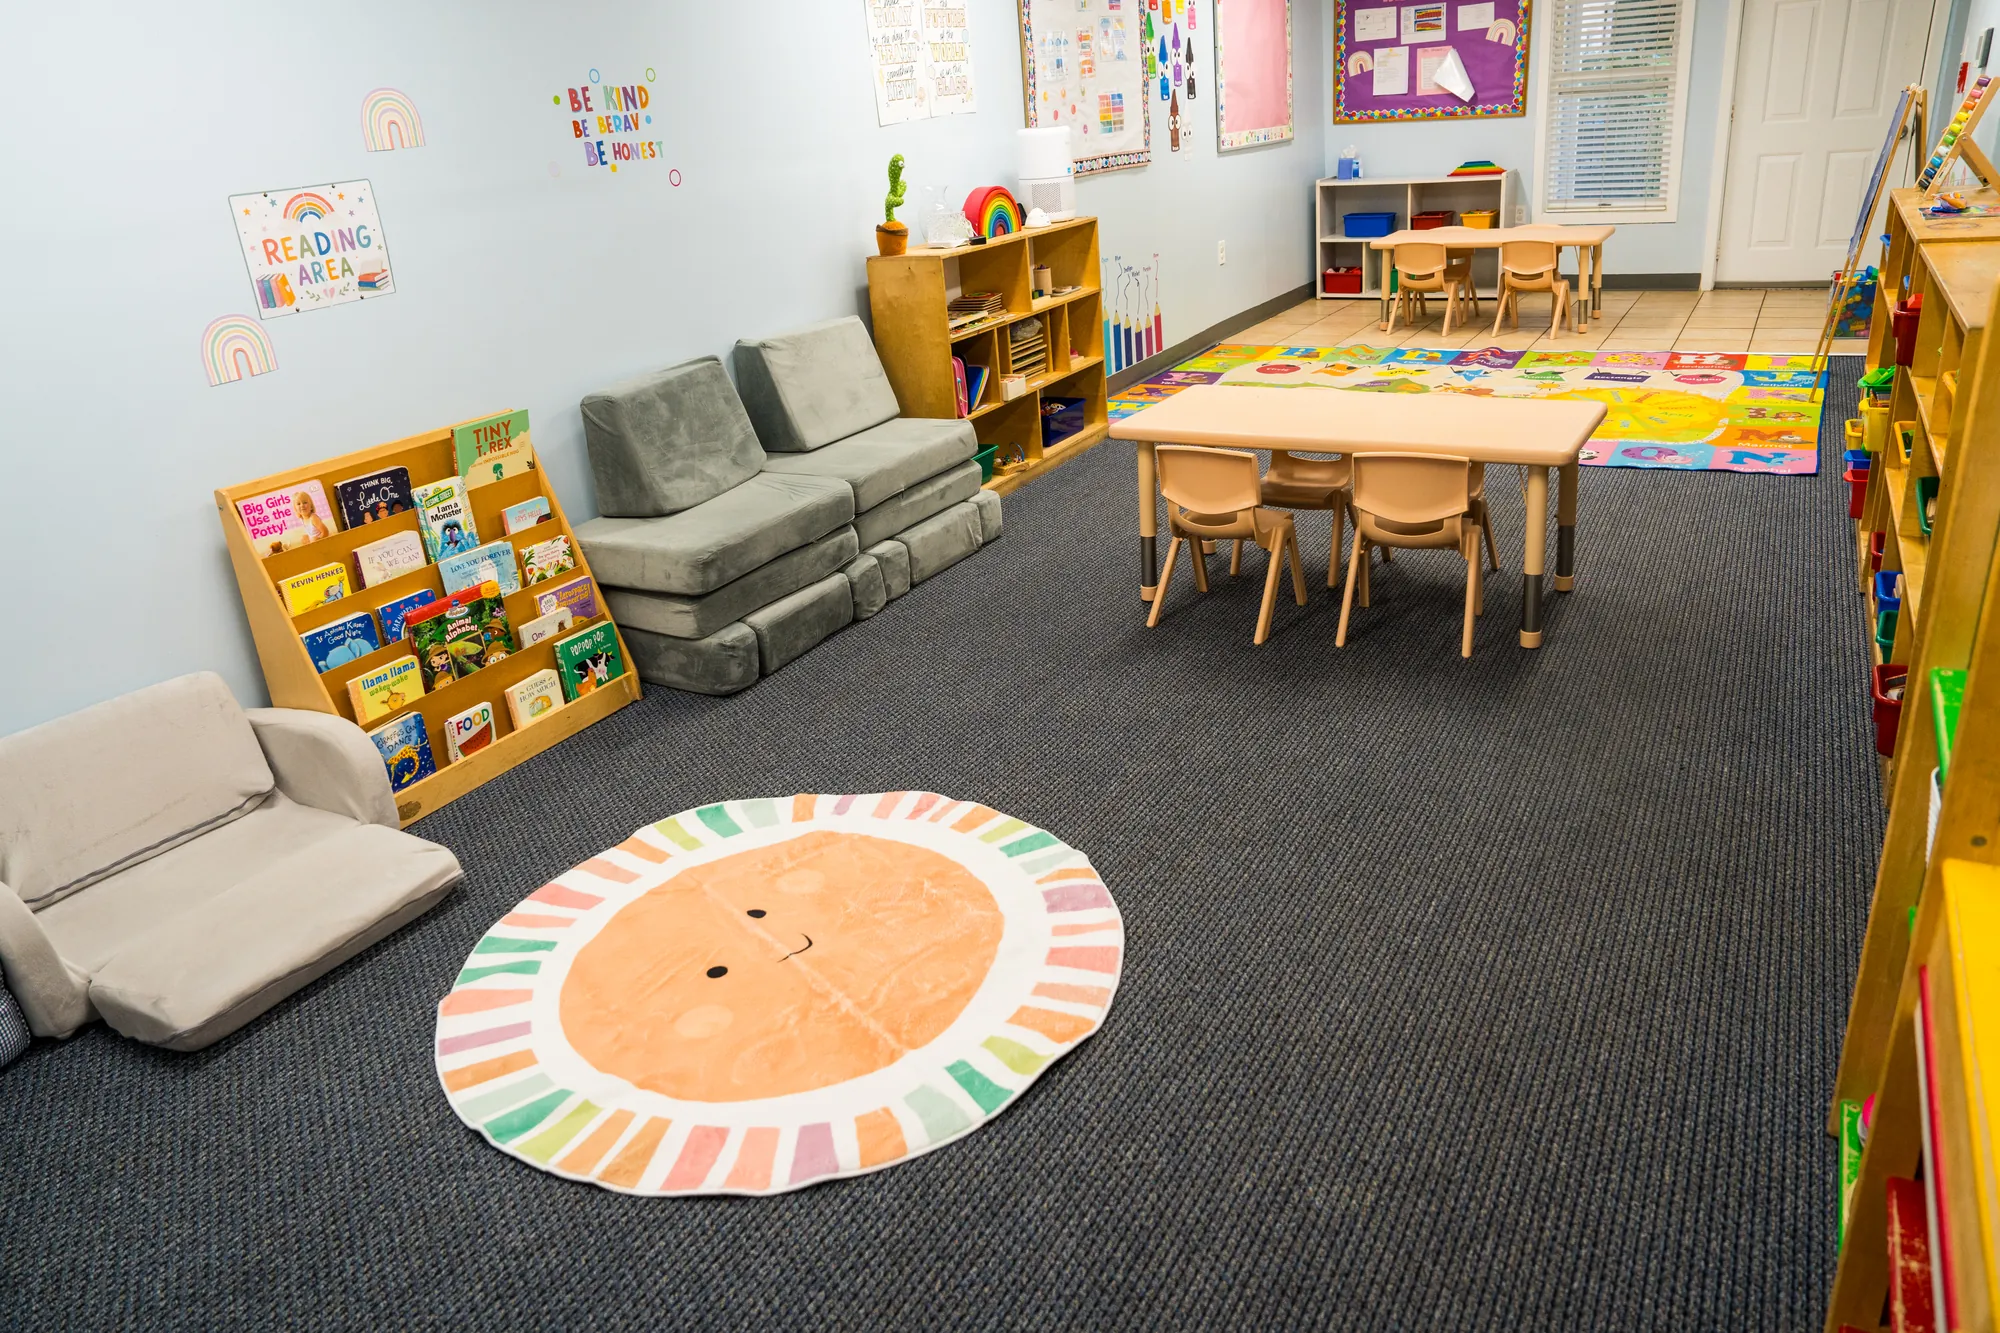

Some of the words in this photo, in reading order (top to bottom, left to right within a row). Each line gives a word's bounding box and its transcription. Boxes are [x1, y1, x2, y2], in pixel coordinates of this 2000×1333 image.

[873, 6, 912, 28] TODAY
[877, 41, 918, 66] LEARN
[930, 41, 967, 63] WORLD
[935, 74, 969, 97] CLASS
[567, 86, 594, 113] BE
[602, 84, 650, 112] KIND
[572, 118, 590, 138] BE
[596, 112, 640, 134] BERAV
[584, 140, 608, 167] BE
[612, 140, 664, 161] HONEST
[261, 224, 372, 266] READING
[298, 256, 355, 287] AREA
[472, 419, 512, 445] TINY
[489, 436, 513, 454] REX
[1733, 466, 1792, 474] Narwhal
[360, 479, 380, 490] THINK
[242, 503, 264, 517] Big
[265, 493, 291, 510] Girls
[357, 491, 381, 511] Little
[379, 485, 400, 502] One
[436, 506, 441, 514] I
[441, 504, 453, 513] am
[453, 501, 459, 509] a
[246, 513, 271, 528] Use
[272, 506, 292, 520] the
[430, 507, 463, 523] Monster
[251, 519, 288, 540] Potty!
[450, 562, 467, 574] LOVE
[466, 557, 480, 567] YOU
[480, 548, 512, 563] FOREVER
[290, 576, 315, 589] KEVIN
[315, 566, 345, 581] HENKES
[445, 624, 478, 643] Alphabet
[446, 616, 472, 632] Animal
[327, 633, 345, 644] Good
[344, 629, 362, 638] Night
[531, 630, 546, 642] One
[361, 673, 389, 691] llama
[389, 661, 416, 678] llama
[526, 678, 547, 692] GUESS
[519, 690, 536, 703] HOW
[536, 680, 557, 696] MUCH
[456, 708, 490, 736] FOOD
[386, 735, 413, 754] DANCE
